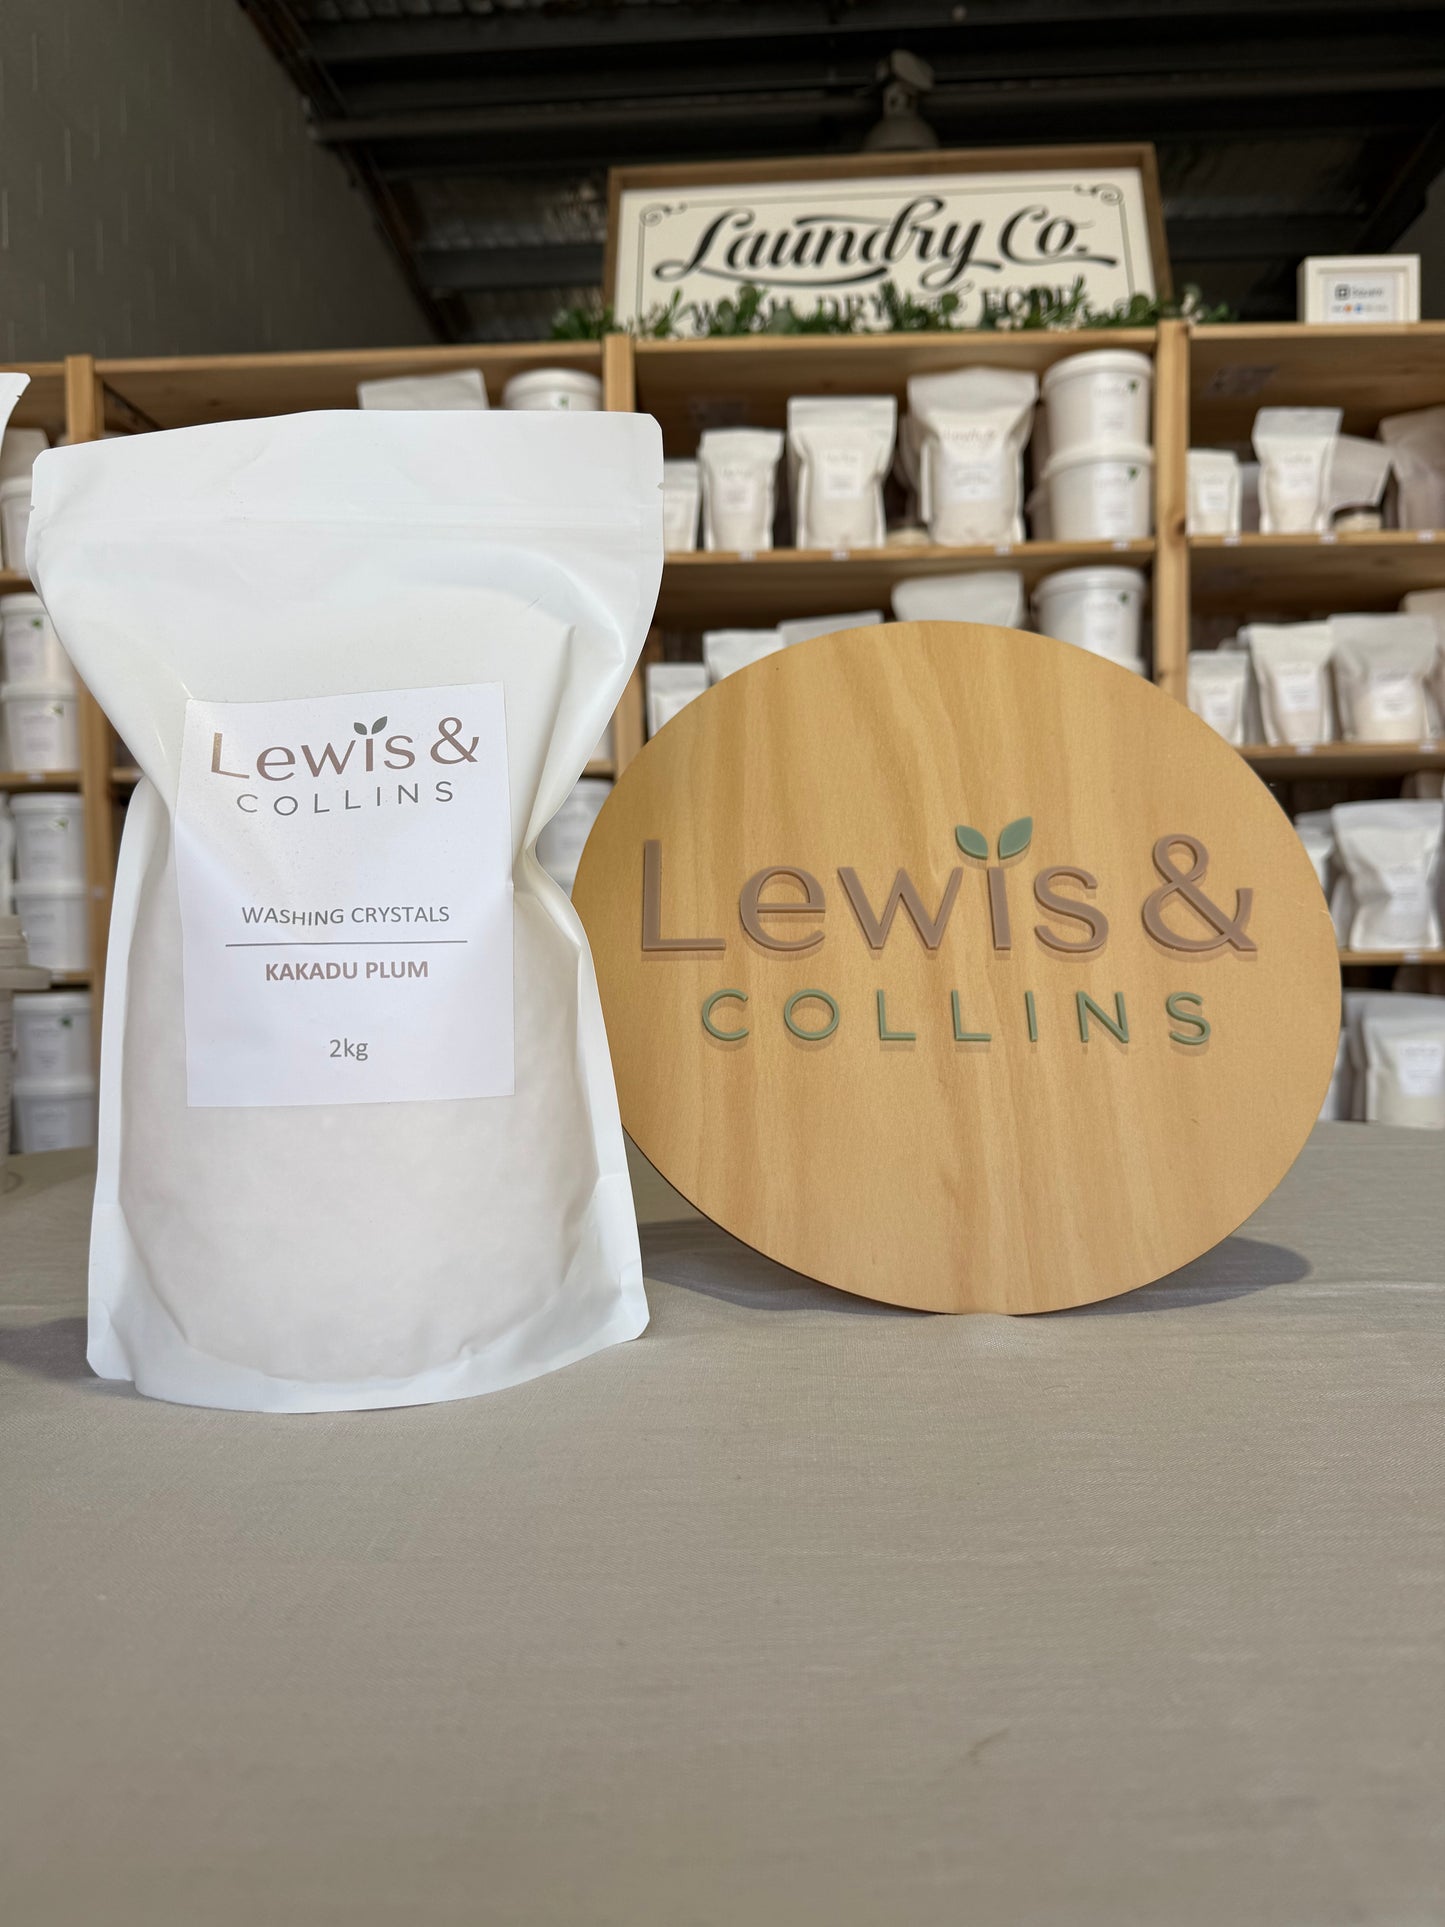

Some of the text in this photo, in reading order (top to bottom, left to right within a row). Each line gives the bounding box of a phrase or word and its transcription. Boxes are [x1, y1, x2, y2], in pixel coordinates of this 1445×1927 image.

[654, 196, 1118, 291] Laundry Co.
[211, 716, 480, 782] Lewis &
[237, 781, 453, 816] COLLINS
[641, 816, 1258, 953] Lewis &
[242, 906, 450, 926] WASHING CRYSTALS
[265, 961, 429, 981] KAKADU PLUM
[701, 988, 1211, 1046] COLLINS
[329, 1038, 368, 1061] 2kg
